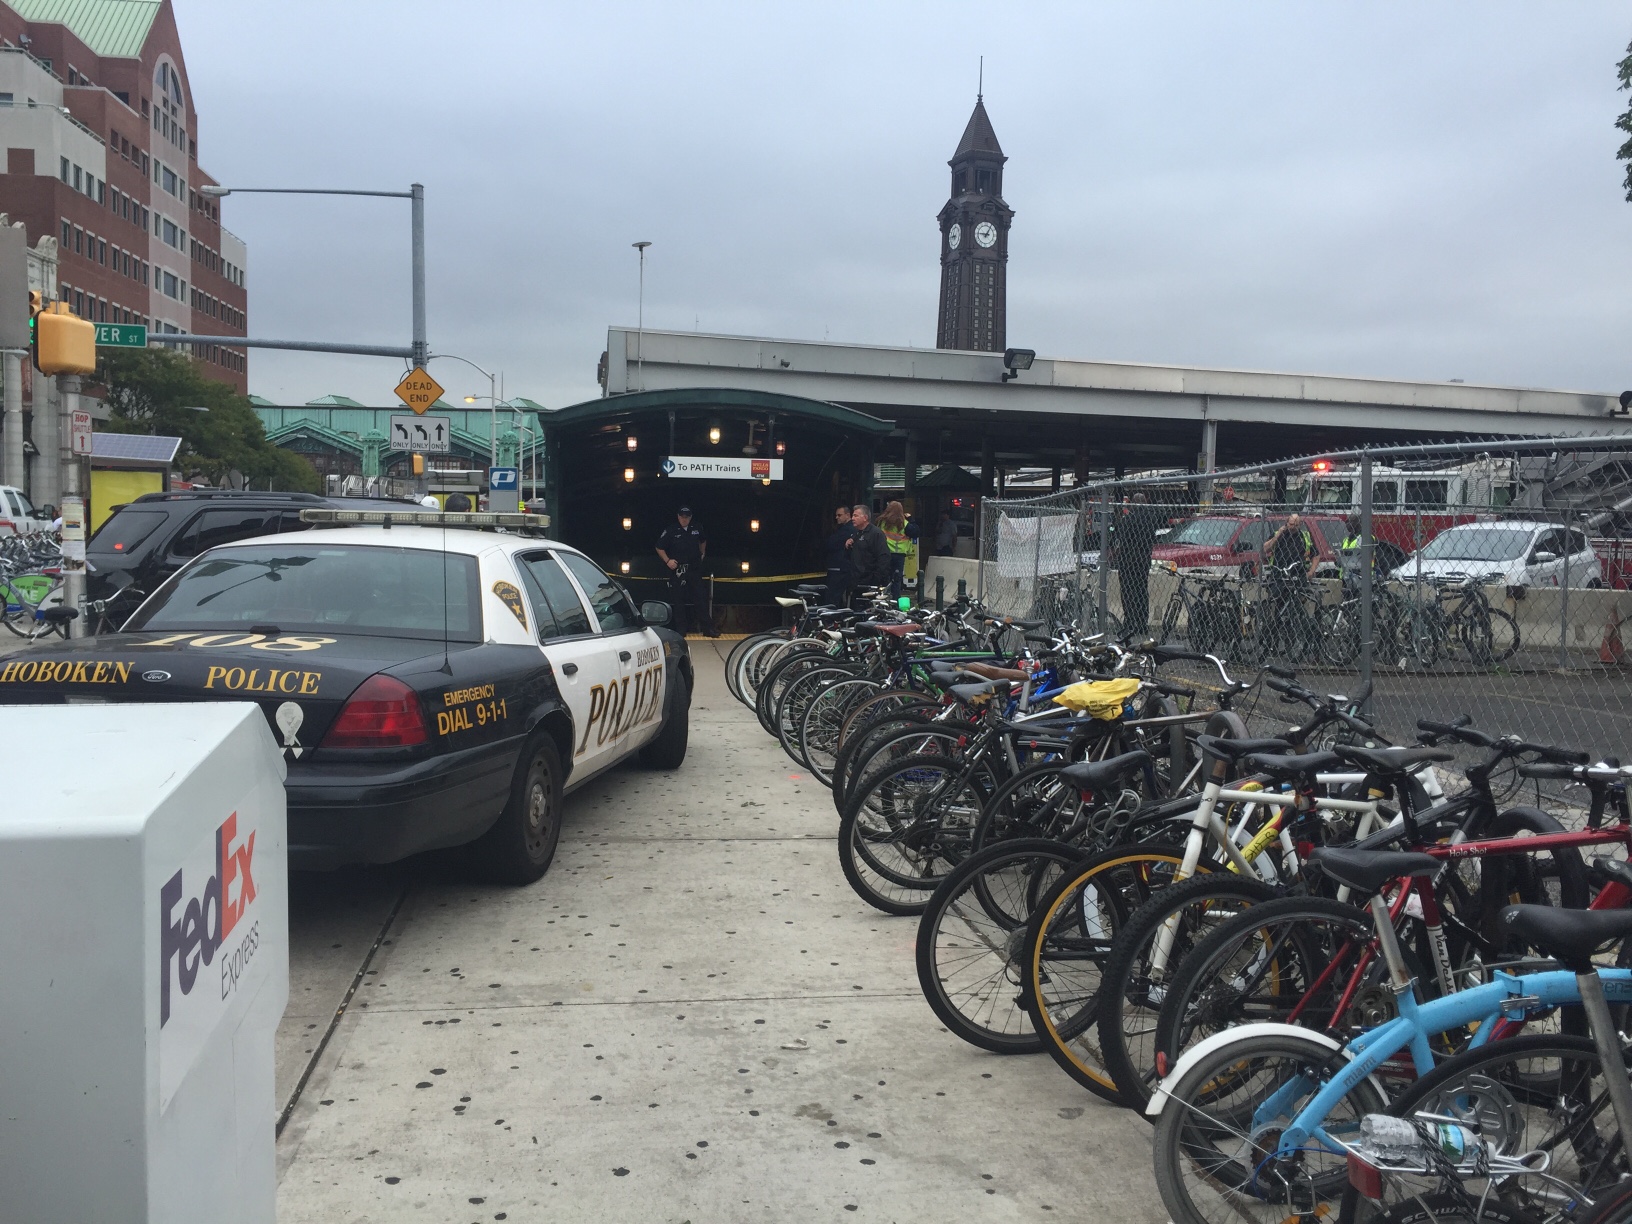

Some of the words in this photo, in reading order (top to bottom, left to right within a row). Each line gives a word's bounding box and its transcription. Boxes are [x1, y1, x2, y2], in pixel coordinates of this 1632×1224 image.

[128, 335, 138, 343] ST
[406, 381, 433, 391] DEAD
[410, 394, 429, 403] END
[75, 414, 89, 423] HOP
[678, 463, 688, 471] To
[690, 463, 713, 472] PATH
[715, 464, 741, 473] Trains
[501, 592, 518, 600] POLICE
[126, 633, 338, 651] 108
[0, 660, 136, 684] HOBOKEN
[204, 666, 322, 694] POLICE
[443, 683, 496, 707] EMERGENCY
[437, 707, 473, 736] DIAL
[476, 698, 508, 726] 9-1-1
[574, 663, 663, 758] POLICE
[1450, 849, 1468, 858] Hole
[1470, 847, 1488, 857] Shot
[160, 810, 256, 1031] FedEx
[1435, 931, 1446, 957] Van
[221, 919, 260, 1002] Express
[1342, 1054, 1377, 1089] miami
